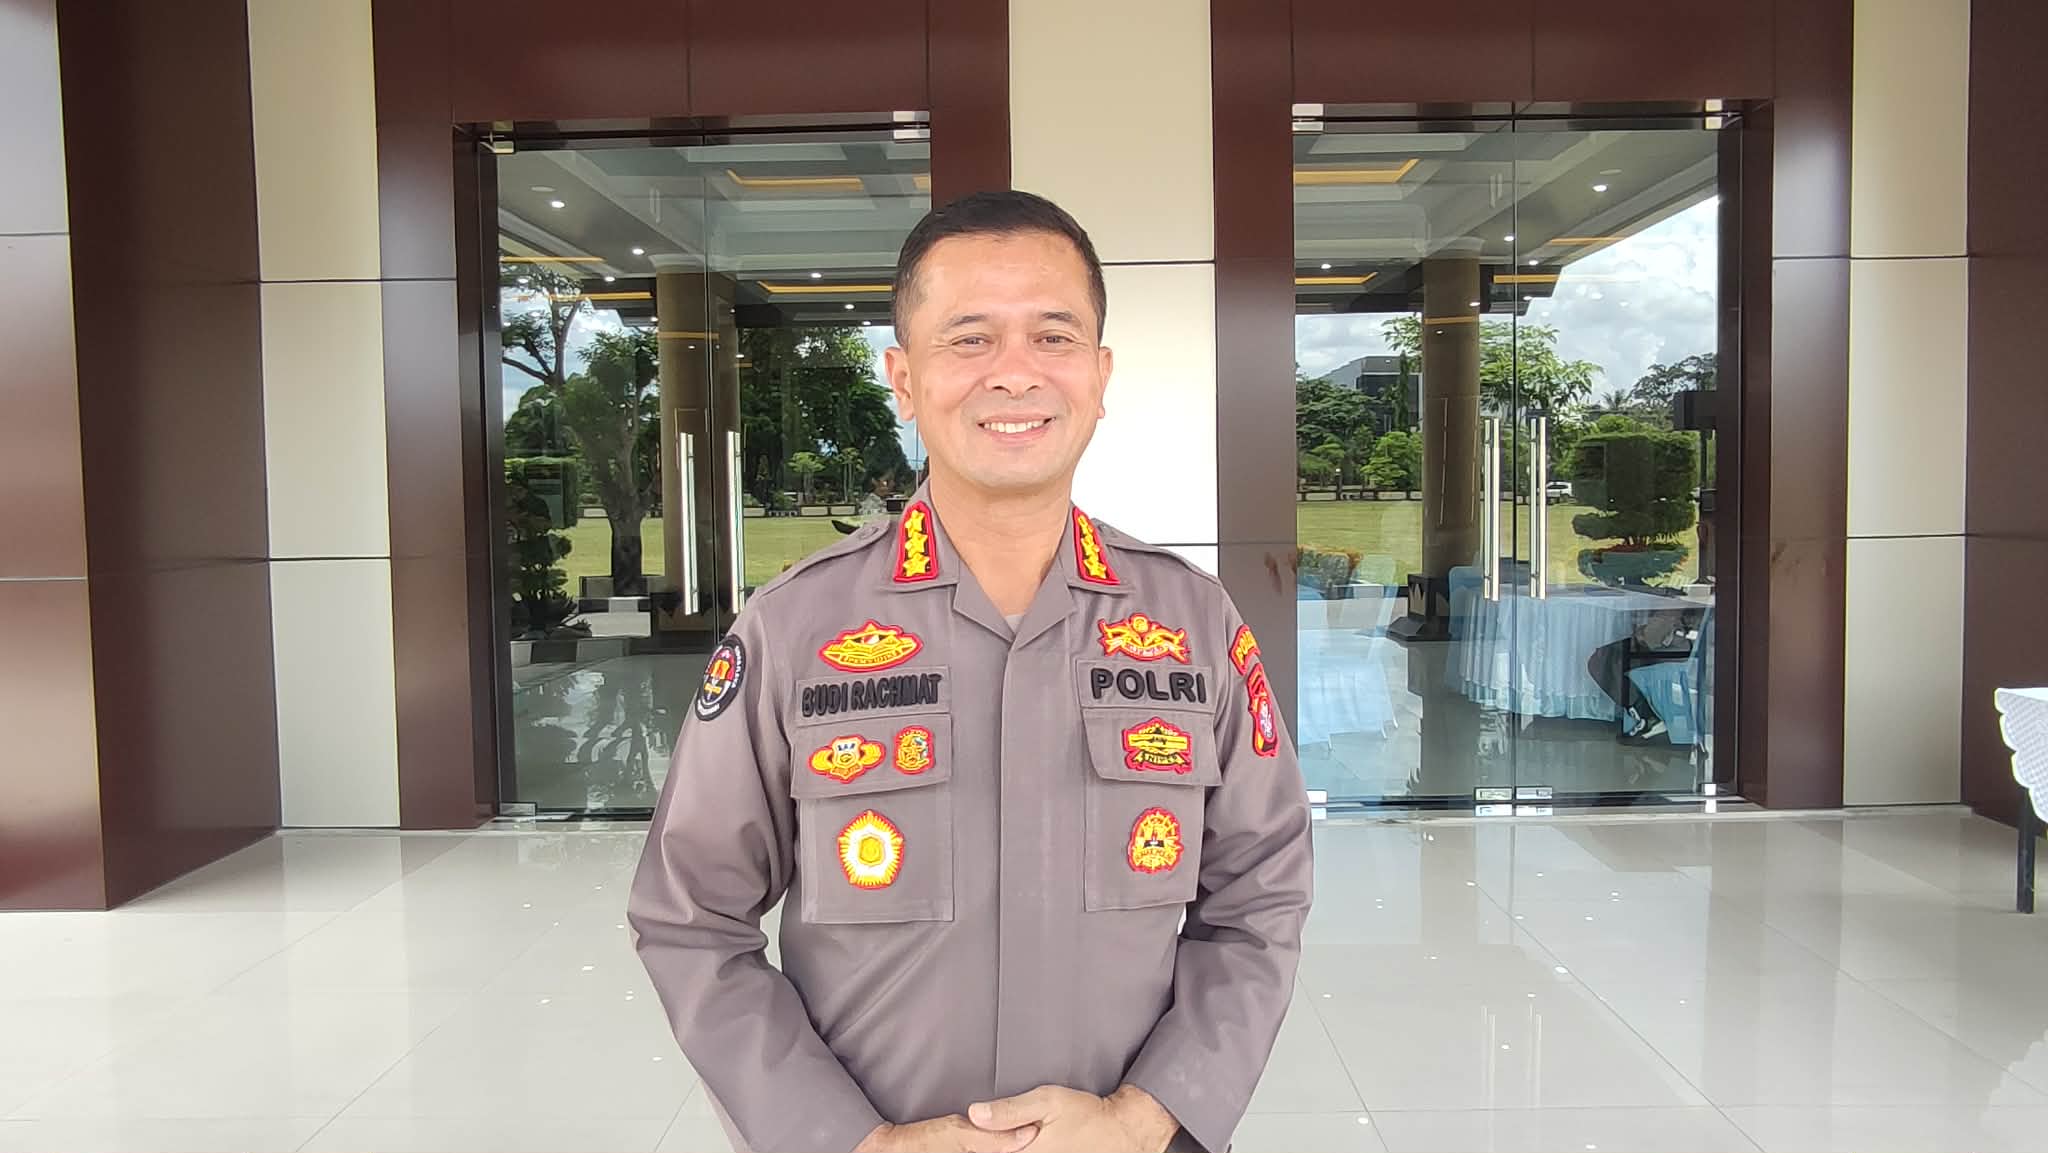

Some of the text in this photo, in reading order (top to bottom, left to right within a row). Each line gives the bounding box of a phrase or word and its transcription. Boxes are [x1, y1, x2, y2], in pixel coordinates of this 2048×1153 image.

[802, 674, 942, 717] BUDI RACHMAT
[1091, 668, 1207, 704] POLRI
